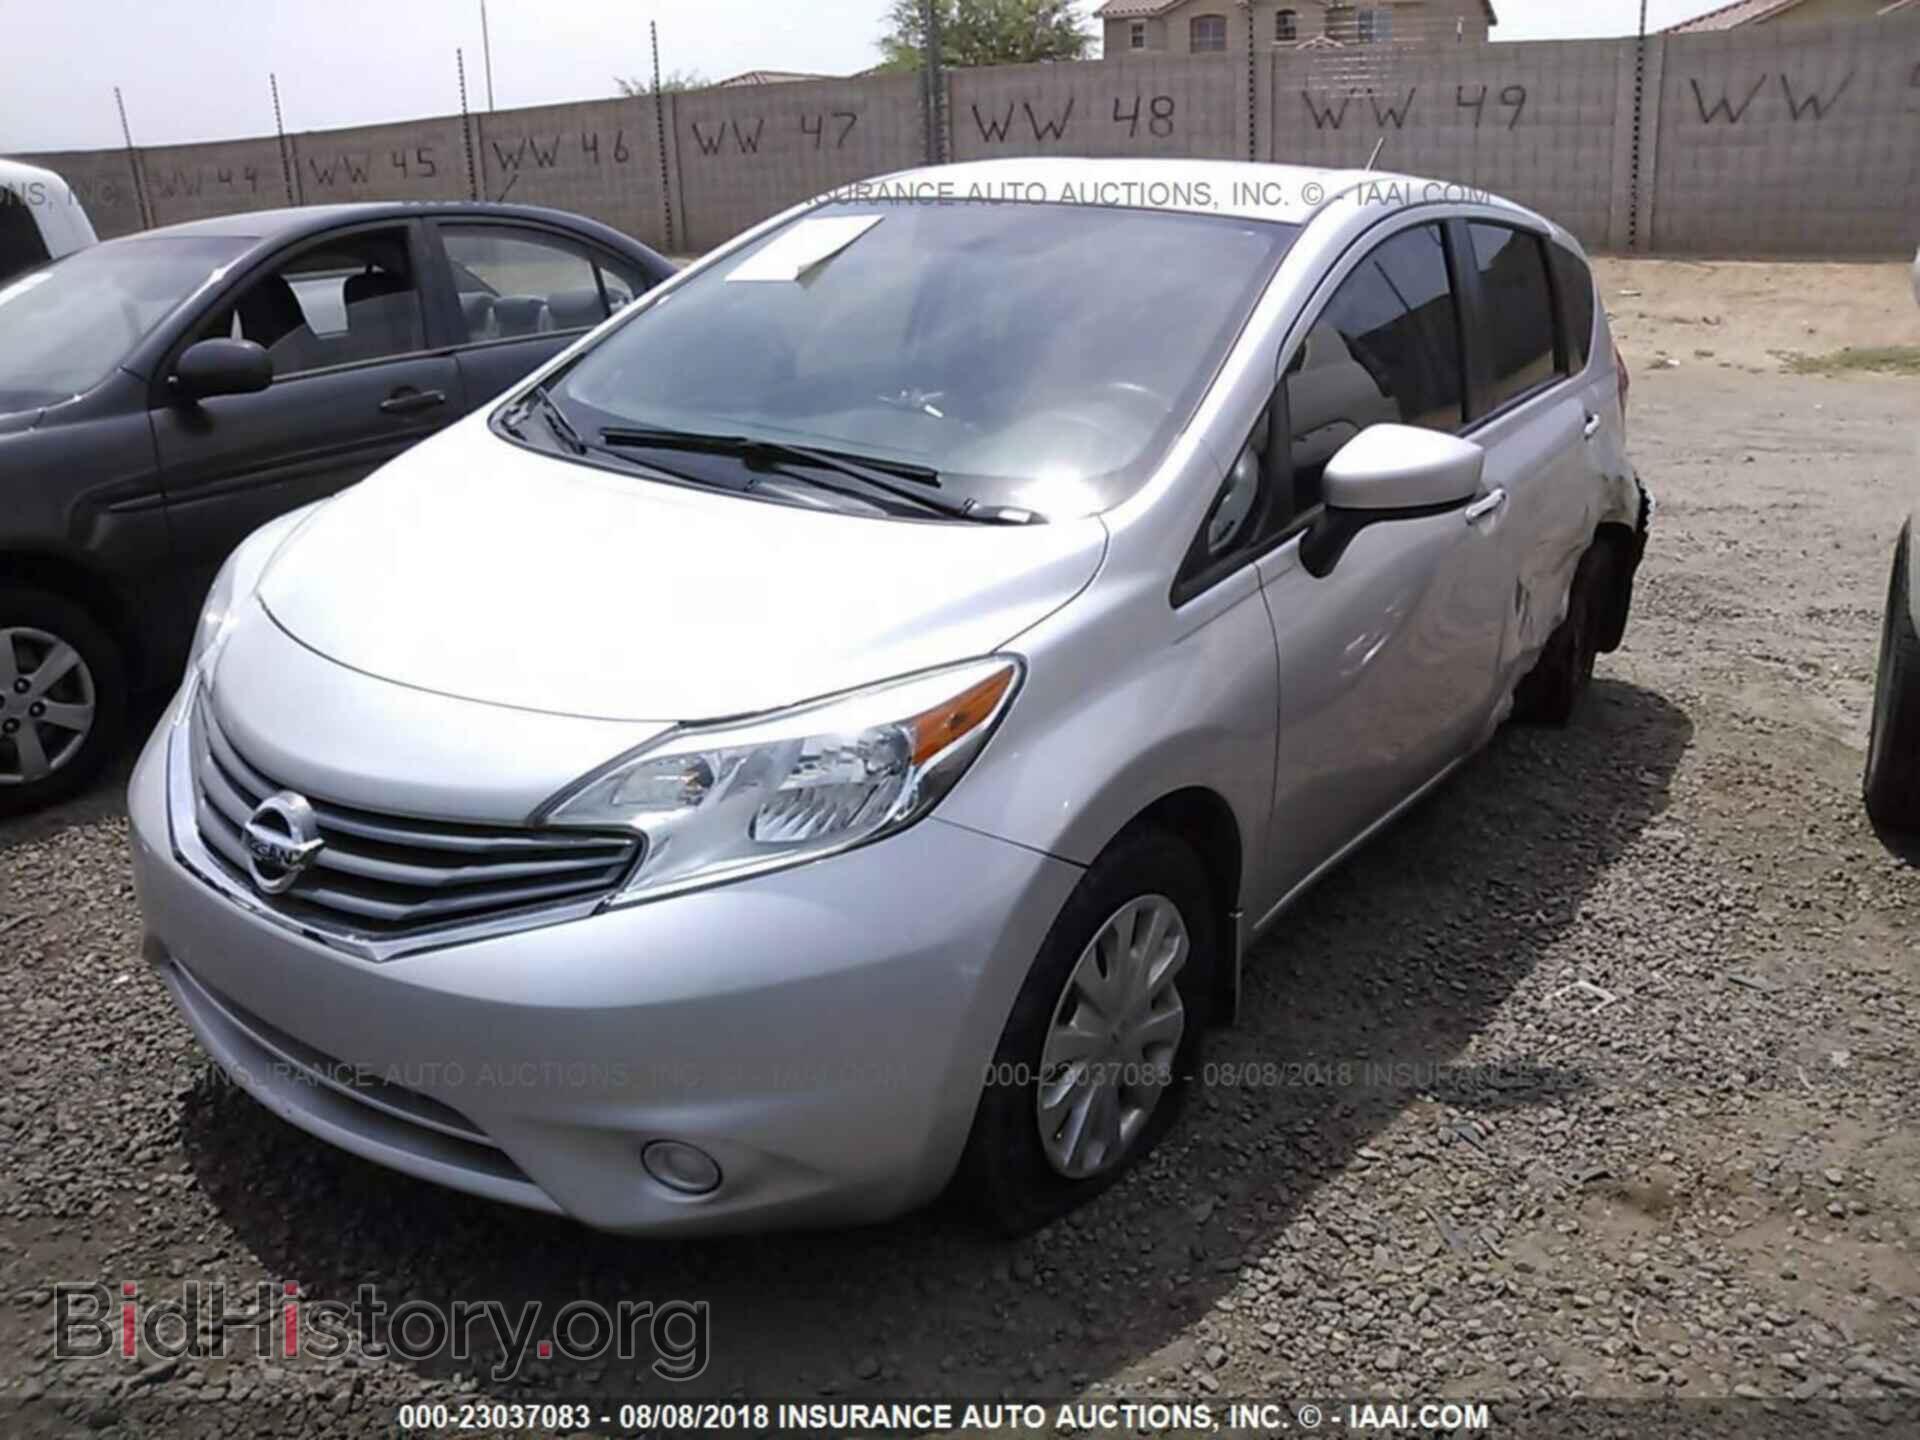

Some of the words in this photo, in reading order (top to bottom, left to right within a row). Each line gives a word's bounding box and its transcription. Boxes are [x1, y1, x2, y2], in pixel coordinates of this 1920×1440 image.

[970, 96, 1075, 144] WW
[1111, 94, 1176, 140] 48
[1300, 86, 1416, 130] WW
[1455, 83, 1529, 131] 49
[491, 133, 561, 172] WW
[580, 128, 630, 167] 46
[691, 118, 765, 157] WW
[799, 111, 858, 150] 47
[308, 153, 372, 188] WW
[391, 144, 438, 180] 45
